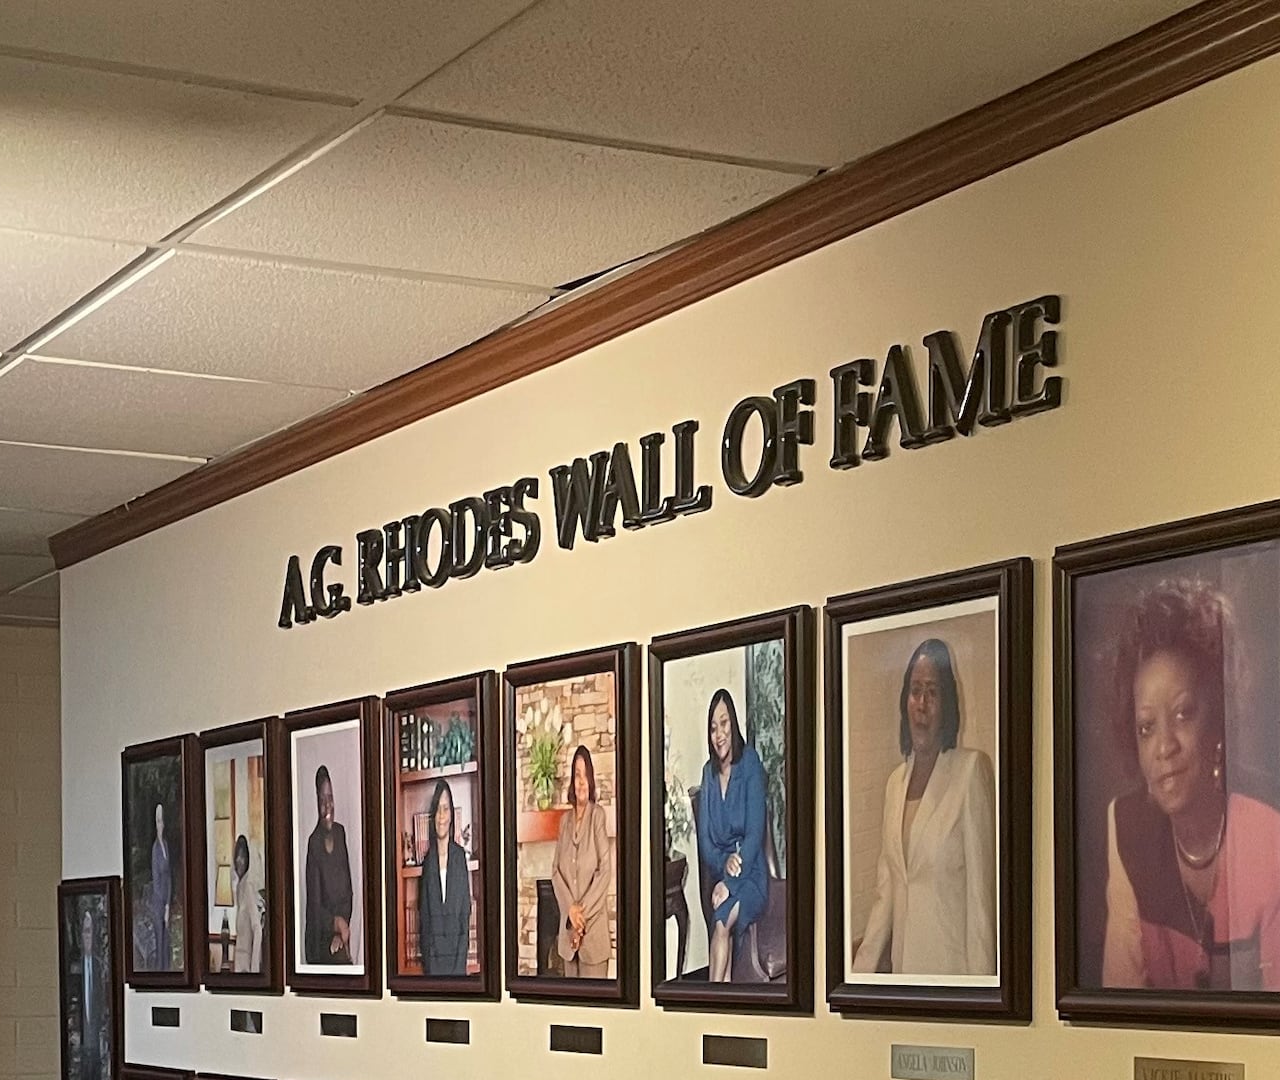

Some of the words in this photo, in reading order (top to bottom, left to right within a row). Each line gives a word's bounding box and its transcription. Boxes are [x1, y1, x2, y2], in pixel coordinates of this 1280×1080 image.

[278, 545, 351, 629] A.G.
[356, 477, 541, 606] RHODES
[549, 420, 712, 549] WALL
[722, 378, 815, 498] OF
[830, 294, 1062, 469] FAME
